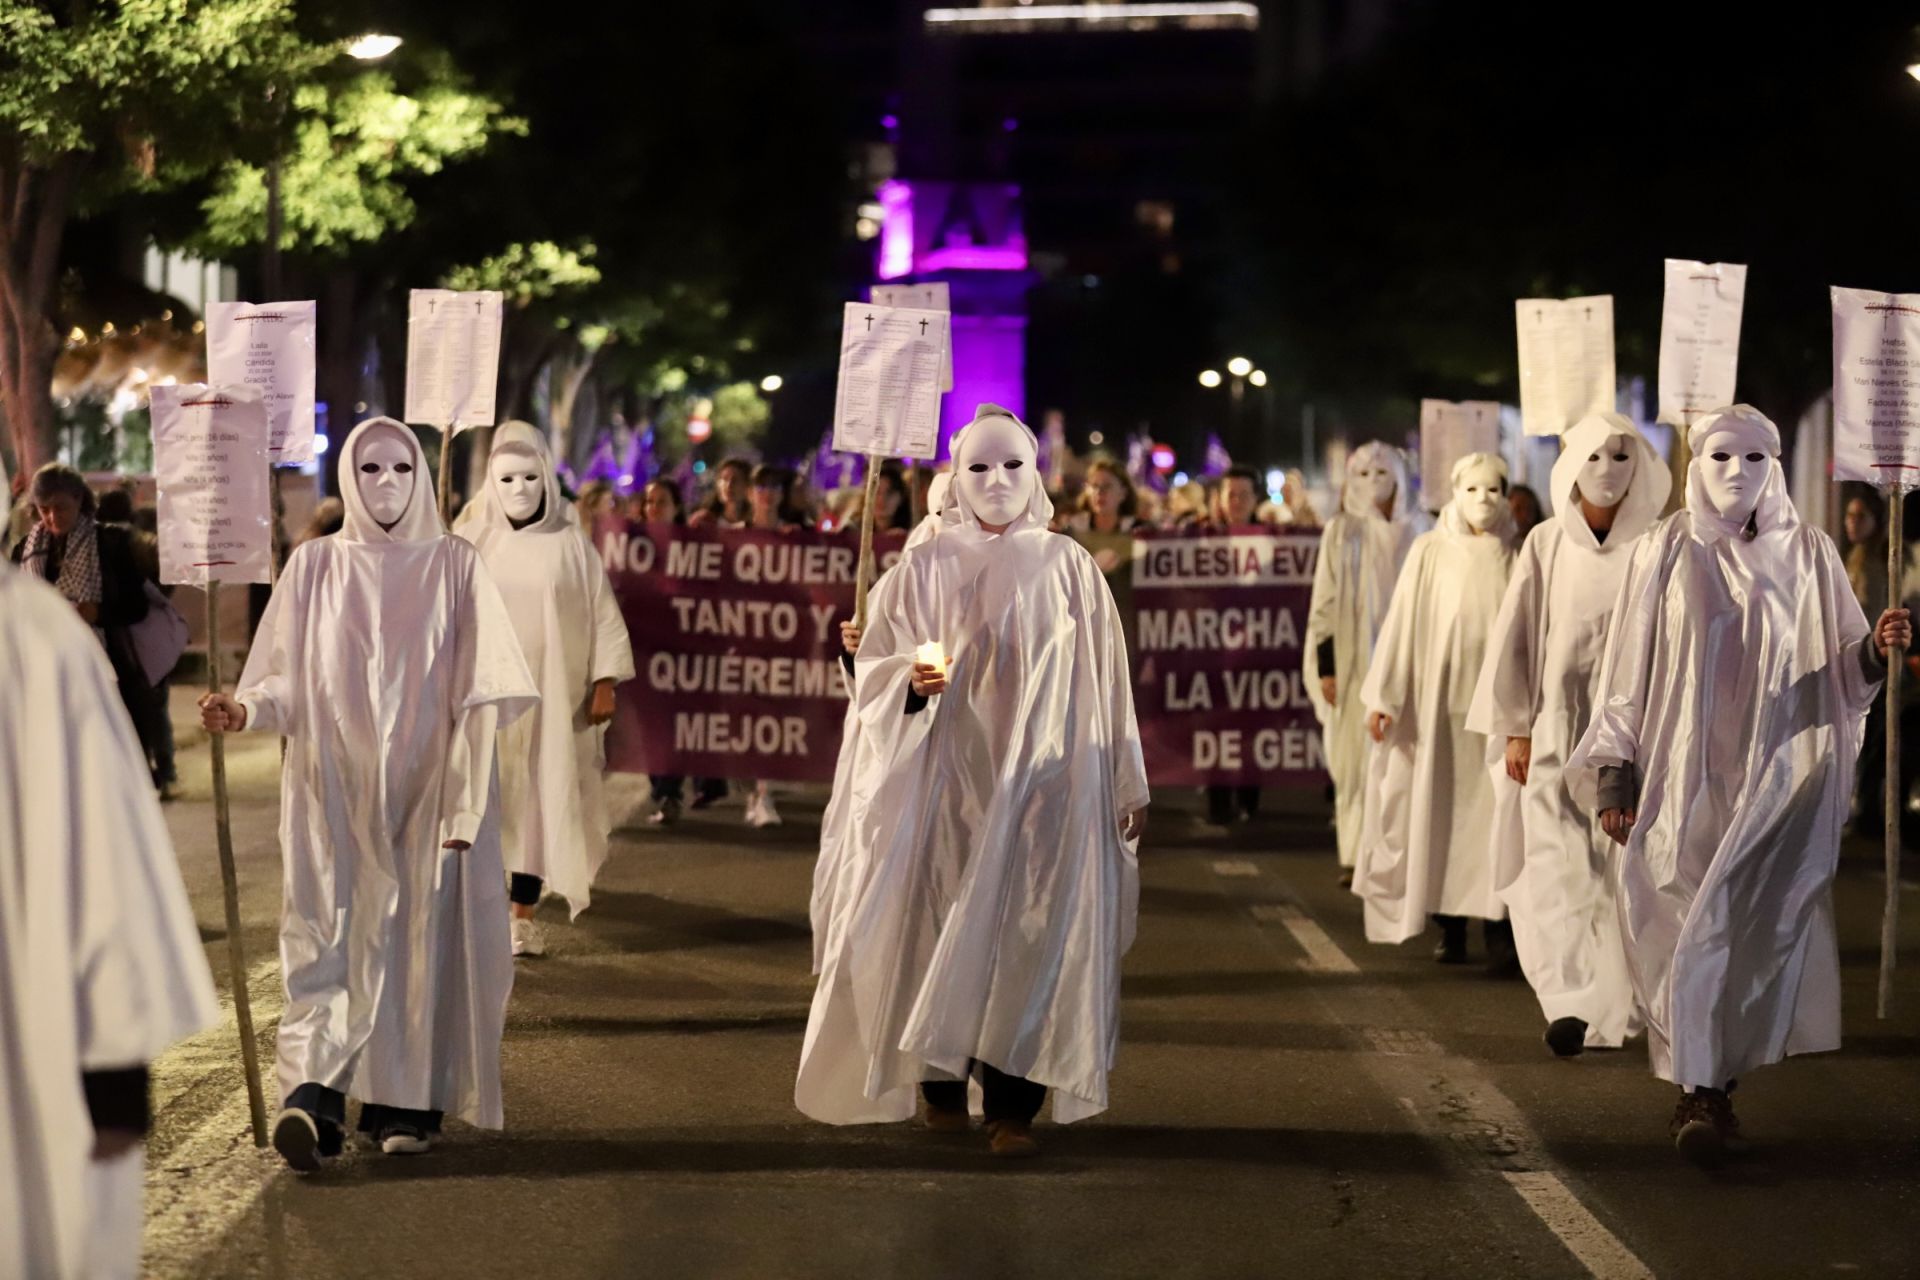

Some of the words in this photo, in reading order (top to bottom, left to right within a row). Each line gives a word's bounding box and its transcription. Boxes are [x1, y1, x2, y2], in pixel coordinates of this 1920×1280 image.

[602, 532, 655, 573] NO
[666, 540, 723, 579] ME
[1144, 545, 1261, 578] IGLESIA
[671, 597, 798, 643] TANTO
[812, 604, 837, 644] Y
[1138, 608, 1299, 651] MARCHA
[649, 647, 848, 699] QUIÉREME
[1165, 671, 1212, 710] LA
[675, 713, 808, 756] MEJOR
[1193, 730, 1242, 770] DE
